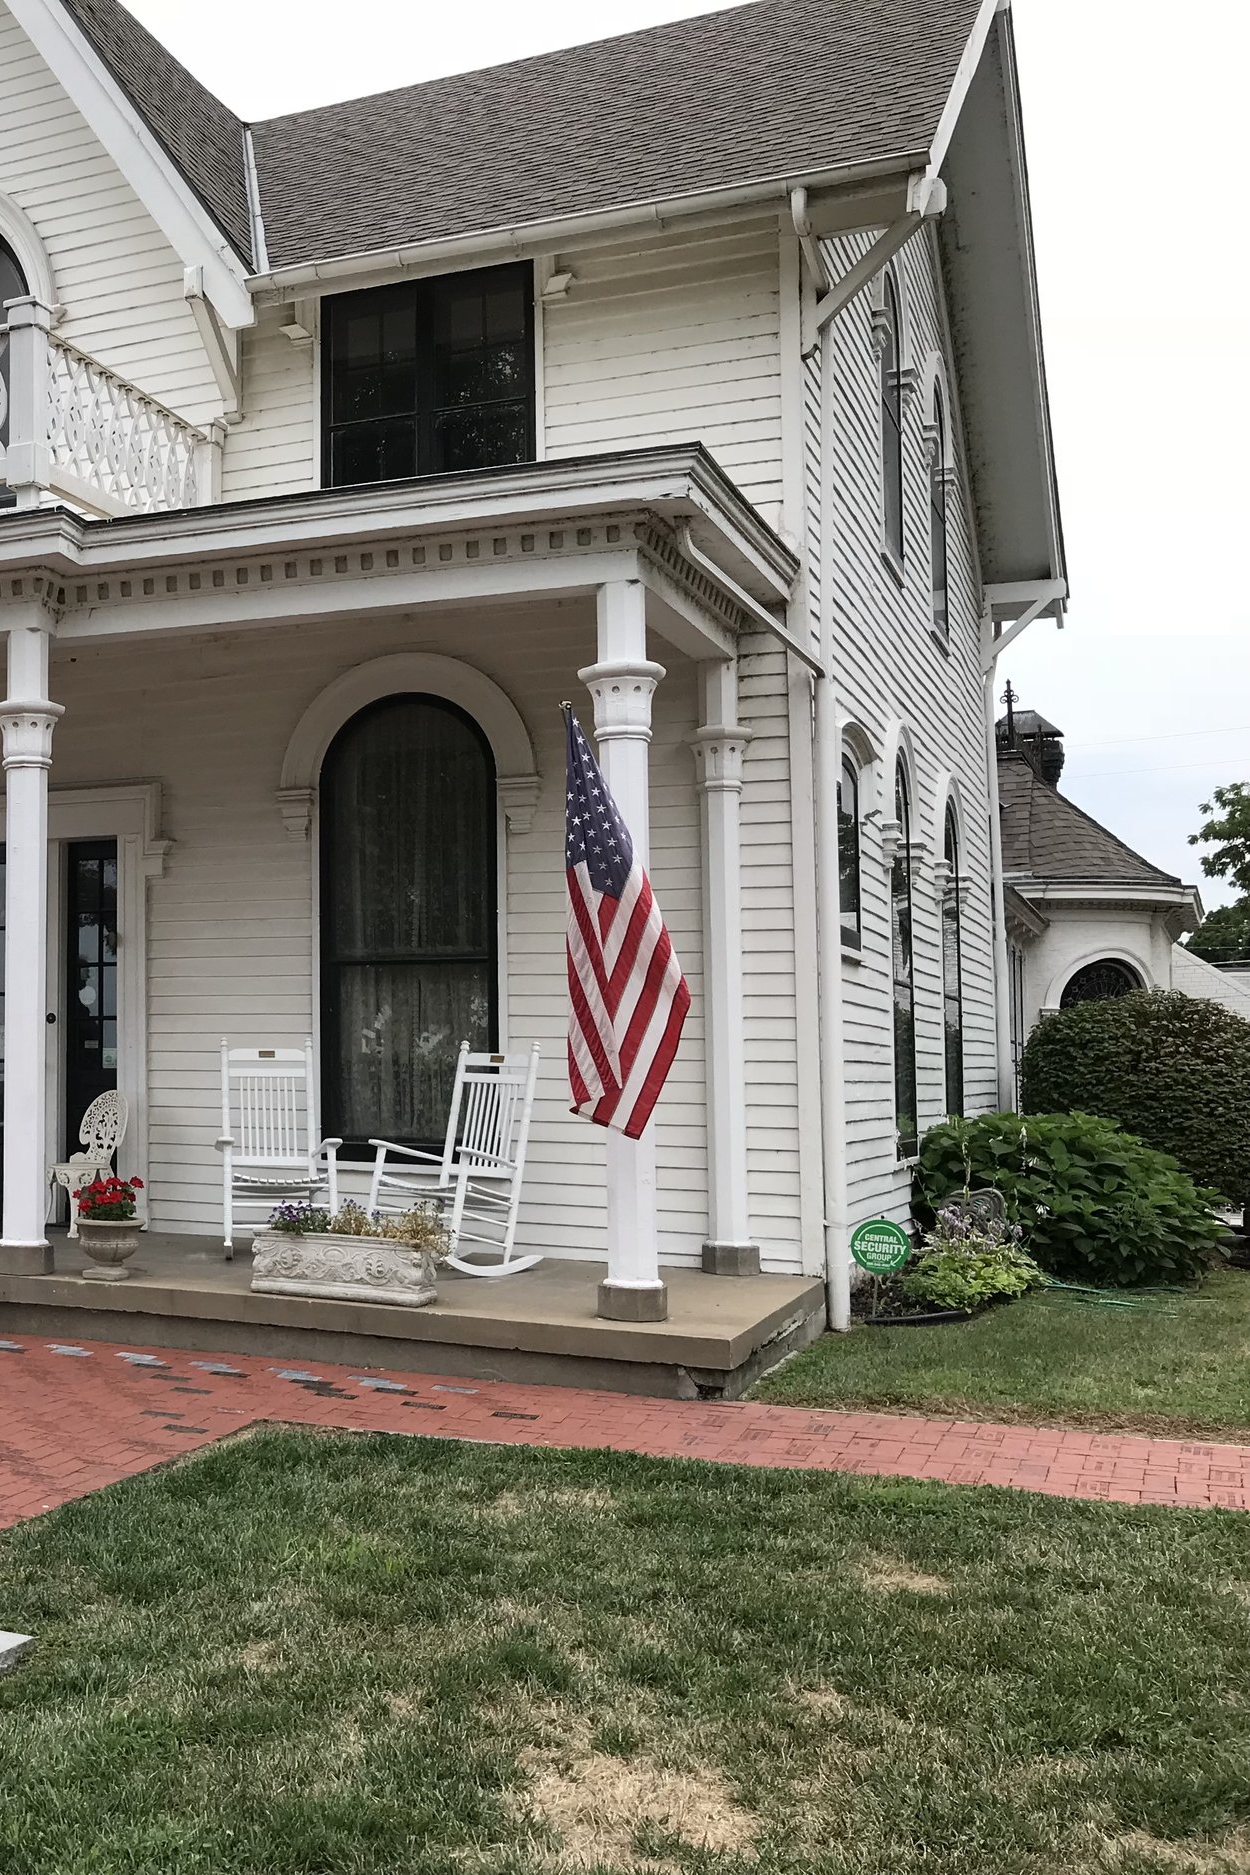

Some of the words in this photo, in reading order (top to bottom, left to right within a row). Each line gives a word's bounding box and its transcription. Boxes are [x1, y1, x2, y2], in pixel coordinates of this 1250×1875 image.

[865, 1234, 898, 1243] CENTRAL
[854, 1241, 906, 1254] SECURITY
[866, 1252, 892, 1261] GROUP
